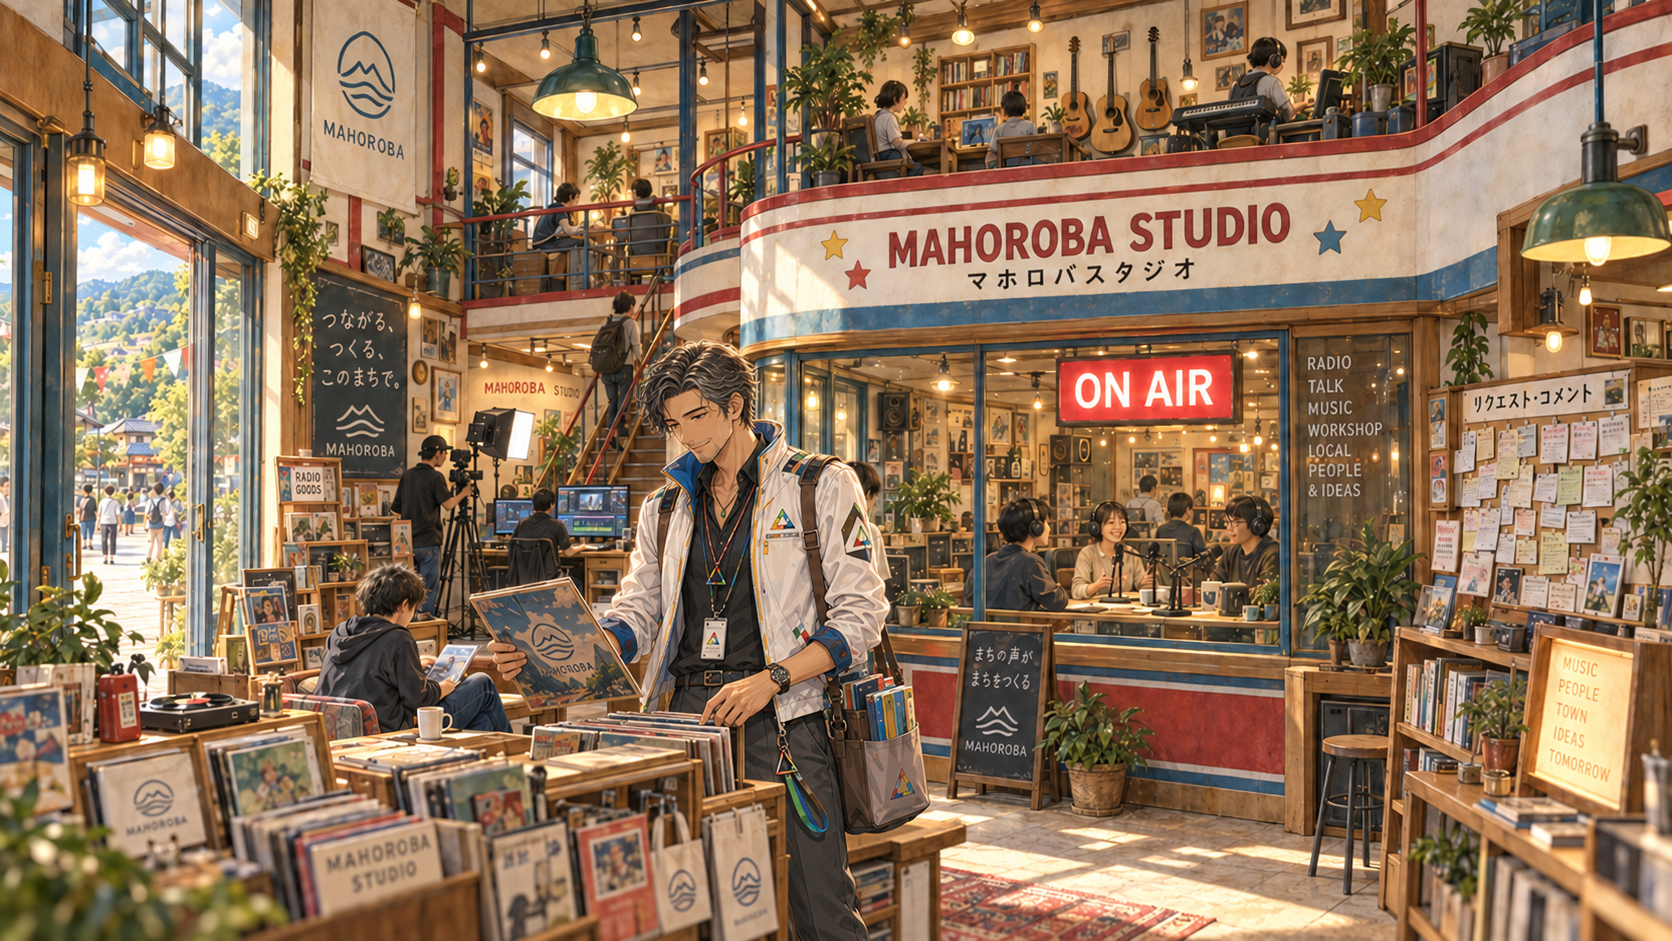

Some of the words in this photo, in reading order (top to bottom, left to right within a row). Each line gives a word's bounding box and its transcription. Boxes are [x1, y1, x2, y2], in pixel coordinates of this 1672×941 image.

[323, 119, 405, 160] MAHOROBA
[888, 215, 1115, 269] MAHOROBA
[1129, 202, 1291, 253] STUDIO
[967, 257, 1196, 291] マホロバスタジオ
[321, 308, 394, 333] つながる、
[329, 338, 384, 361] つくる、
[1307, 355, 1352, 370] RADIO
[321, 366, 400, 390] このまちで。
[1074, 371, 1131, 409] ON
[1144, 368, 1214, 407] AIR
[1308, 378, 1344, 394] TALK
[484, 381, 546, 395] MAHOROBA
[553, 384, 580, 399] STUDIO
[1474, 383, 1592, 413] リクエスト・コメント
[1308, 400, 1353, 416] MUSIC
[1308, 422, 1383, 437] WORKSHOP
[325, 442, 396, 458] MAHOROBA
[1308, 443, 1351, 458] LOCAL
[295, 471, 321, 482] RADIO
[1308, 463, 1362, 478] PEOPLE
[295, 484, 322, 495] GOODS
[1308, 483, 1318, 497] &
[1321, 482, 1361, 497] IDEAS
[974, 646, 1034, 665] まちの声が
[1562, 656, 1599, 678] MUSIC
[971, 670, 1031, 690] まちをつくる
[1558, 678, 1600, 702] PEOPLE
[1556, 702, 1589, 724] TOWN
[1553, 725, 1586, 749] IDEAS
[964, 740, 1028, 757] MAHOROBA
[1549, 748, 1611, 782] TOMORROW
[125, 815, 189, 837] MAHOROBA
[326, 833, 432, 874] MAHOROBA
[351, 860, 418, 893] STUDIO
